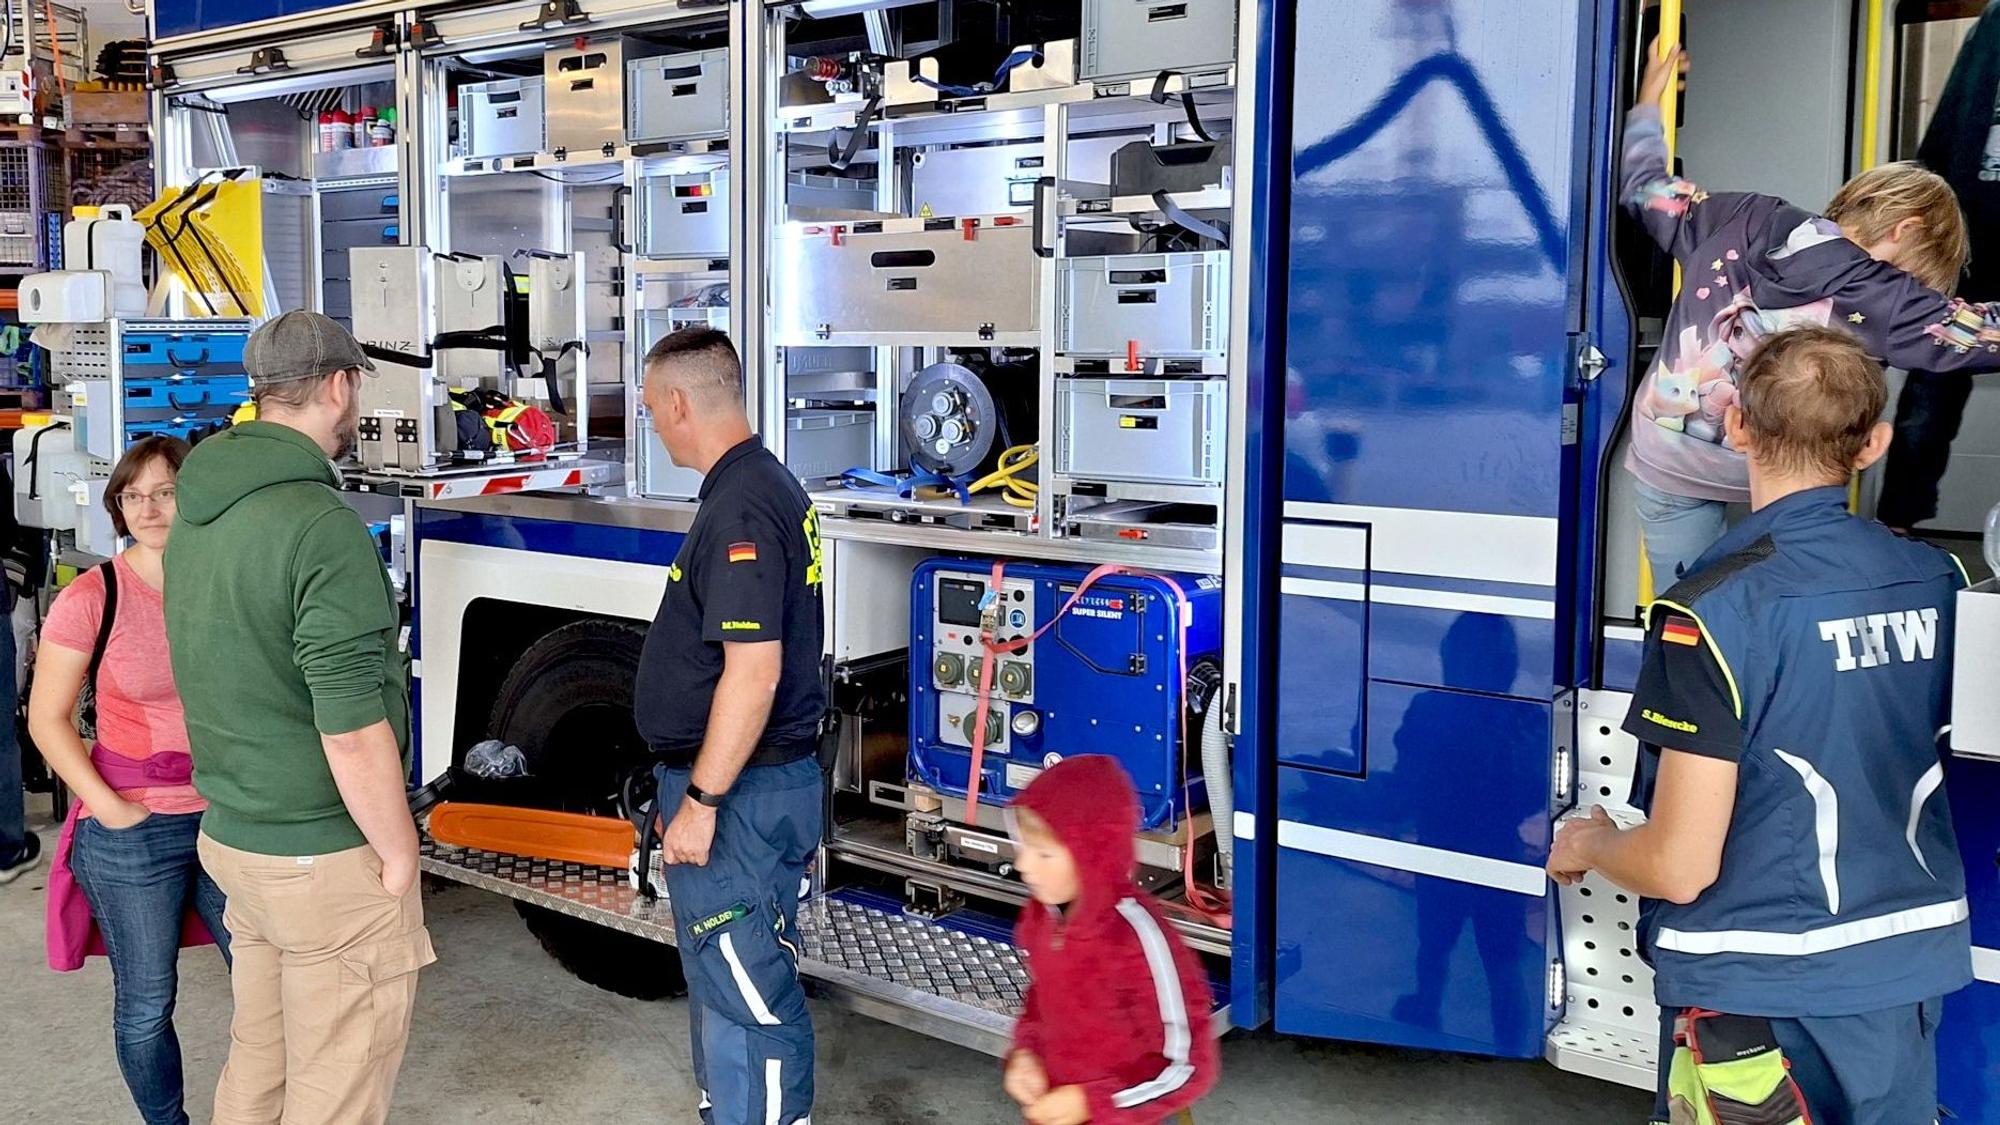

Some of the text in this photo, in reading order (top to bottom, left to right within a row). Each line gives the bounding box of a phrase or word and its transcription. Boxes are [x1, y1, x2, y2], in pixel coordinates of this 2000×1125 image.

[1072, 607, 1122, 619] SUPER SILENT
[1818, 607, 1938, 671] THW
[703, 911, 733, 930] NOLDE
